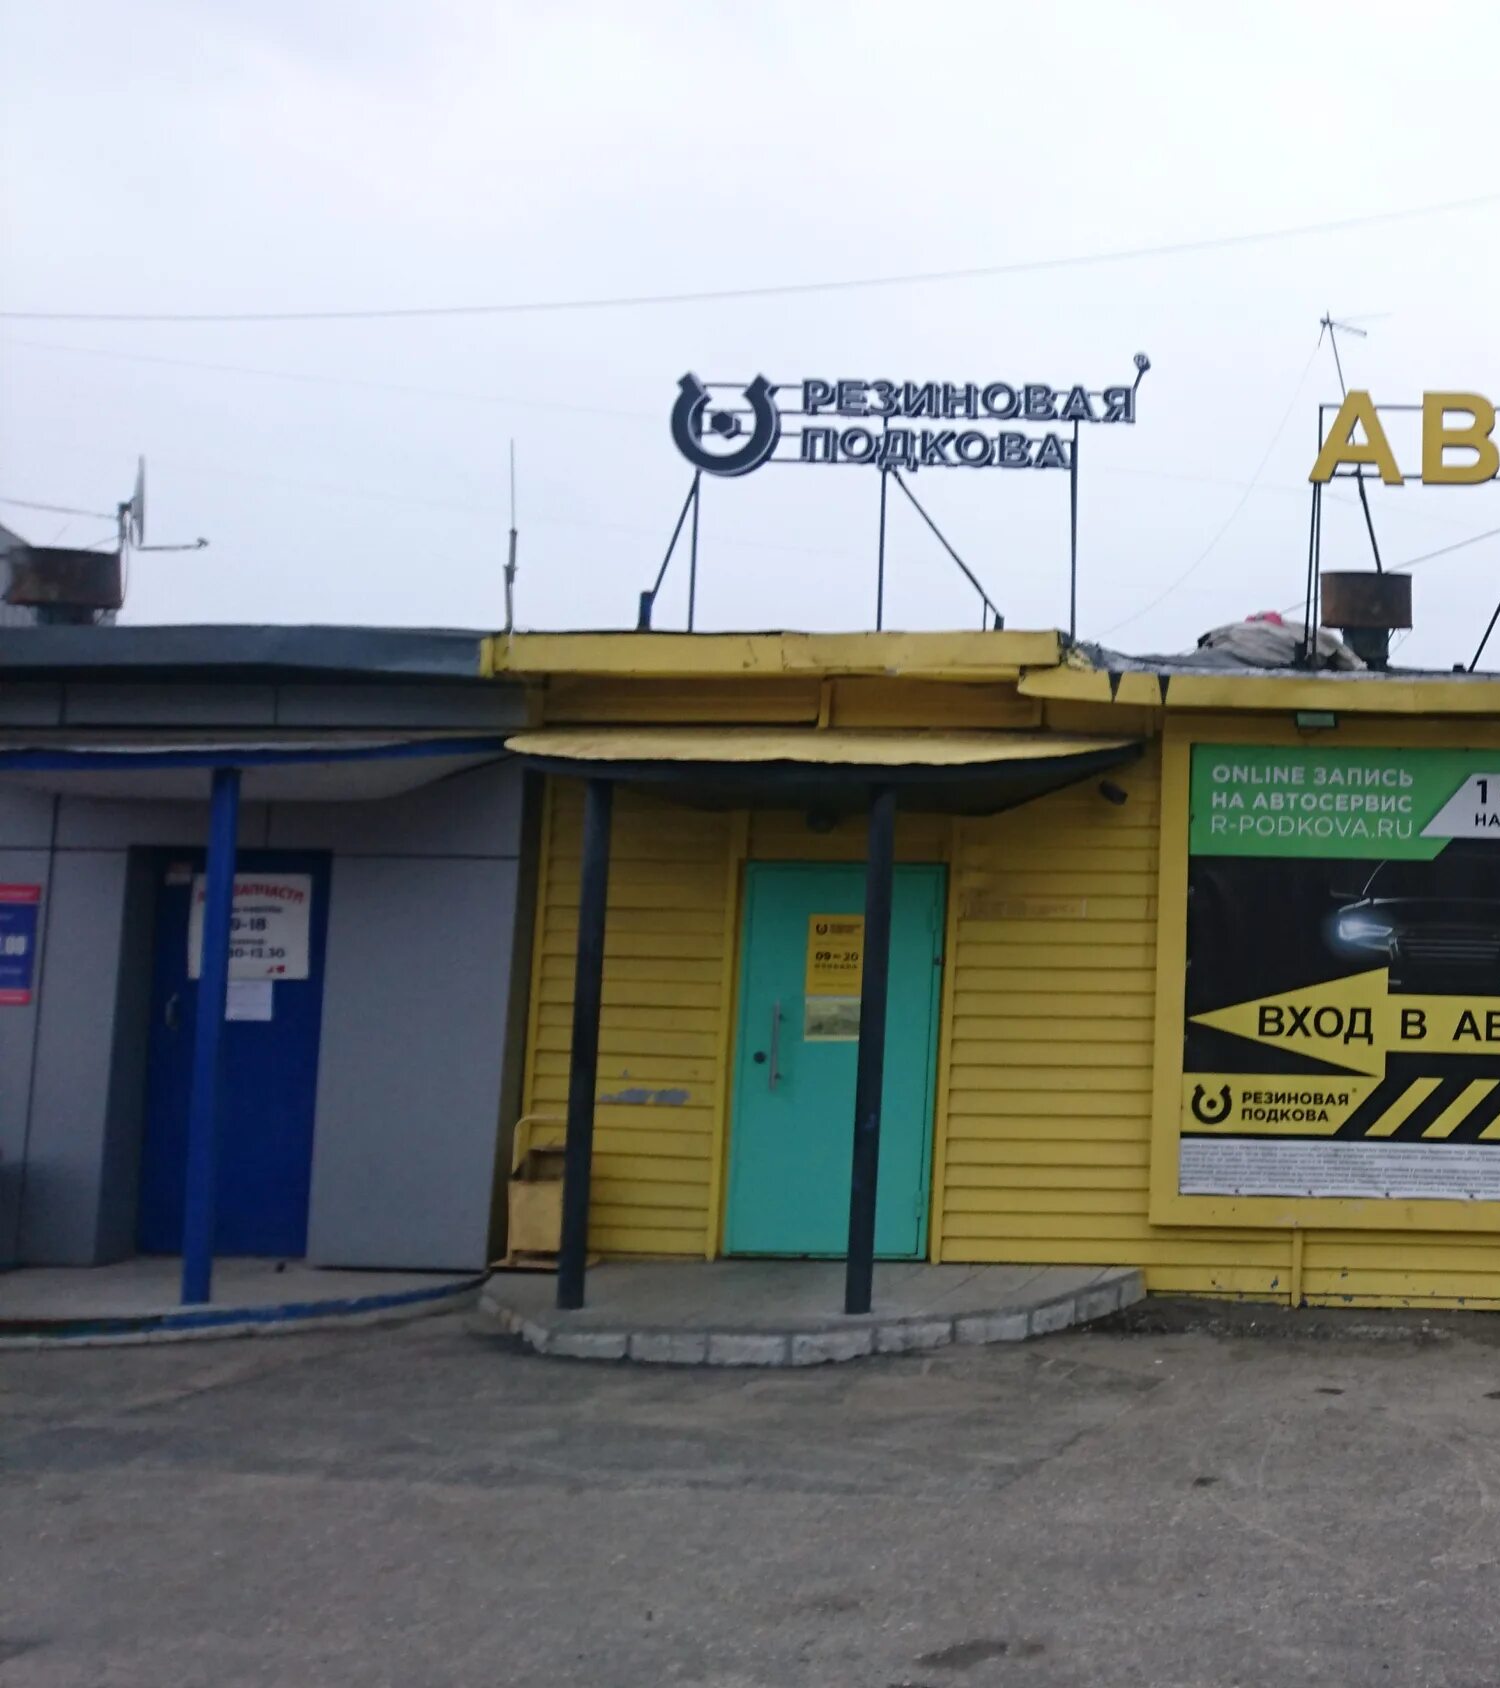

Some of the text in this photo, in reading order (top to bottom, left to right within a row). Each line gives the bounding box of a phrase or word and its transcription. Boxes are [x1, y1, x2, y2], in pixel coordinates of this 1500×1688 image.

[801, 379, 1136, 424] РЕЗИНОВАЯ
[801, 427, 1073, 471] ПОДКОВА
[1212, 765, 1413, 787] ONLINE ЗАПИСЬ
[1211, 791, 1413, 813] НА АВТОСЕРВИС
[1476, 779, 1487, 804] 1
[1211, 814, 1413, 839] R-PODKOVA.RU
[1475, 813, 1500, 827] НА
[1258, 1006, 1373, 1045] ВХОД
[1401, 1009, 1427, 1039] В
[1242, 1091, 1349, 1106] РЕЗИНОВАЯ
[1241, 1108, 1329, 1123] ПОДКОВА
